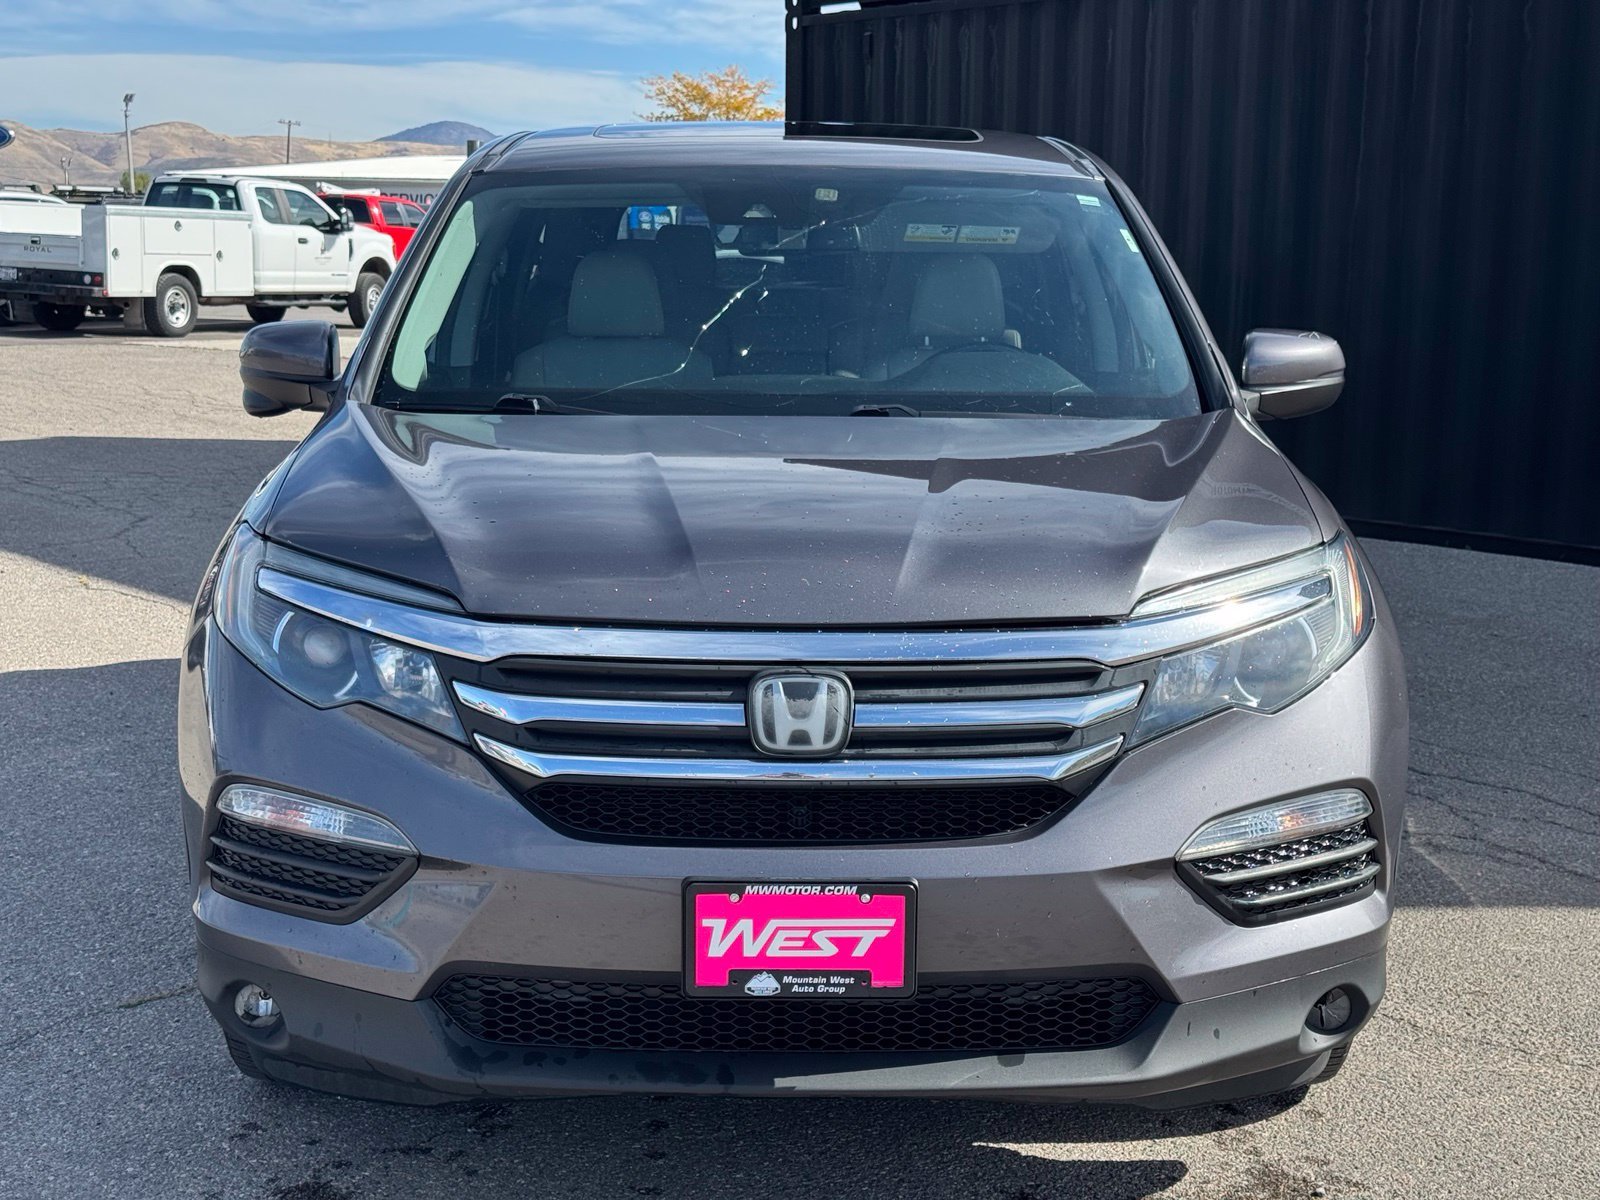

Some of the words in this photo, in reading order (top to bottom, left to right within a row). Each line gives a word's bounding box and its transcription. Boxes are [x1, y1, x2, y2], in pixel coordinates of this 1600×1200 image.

[24, 245, 52, 253] ROYAL
[744, 885, 858, 895] MWMOTOR.COM
[702, 918, 896, 957] WEST
[782, 975, 827, 984] Mountain
[830, 975, 855, 984] West
[791, 984, 814, 993] Auto
[817, 984, 846, 994] Group
